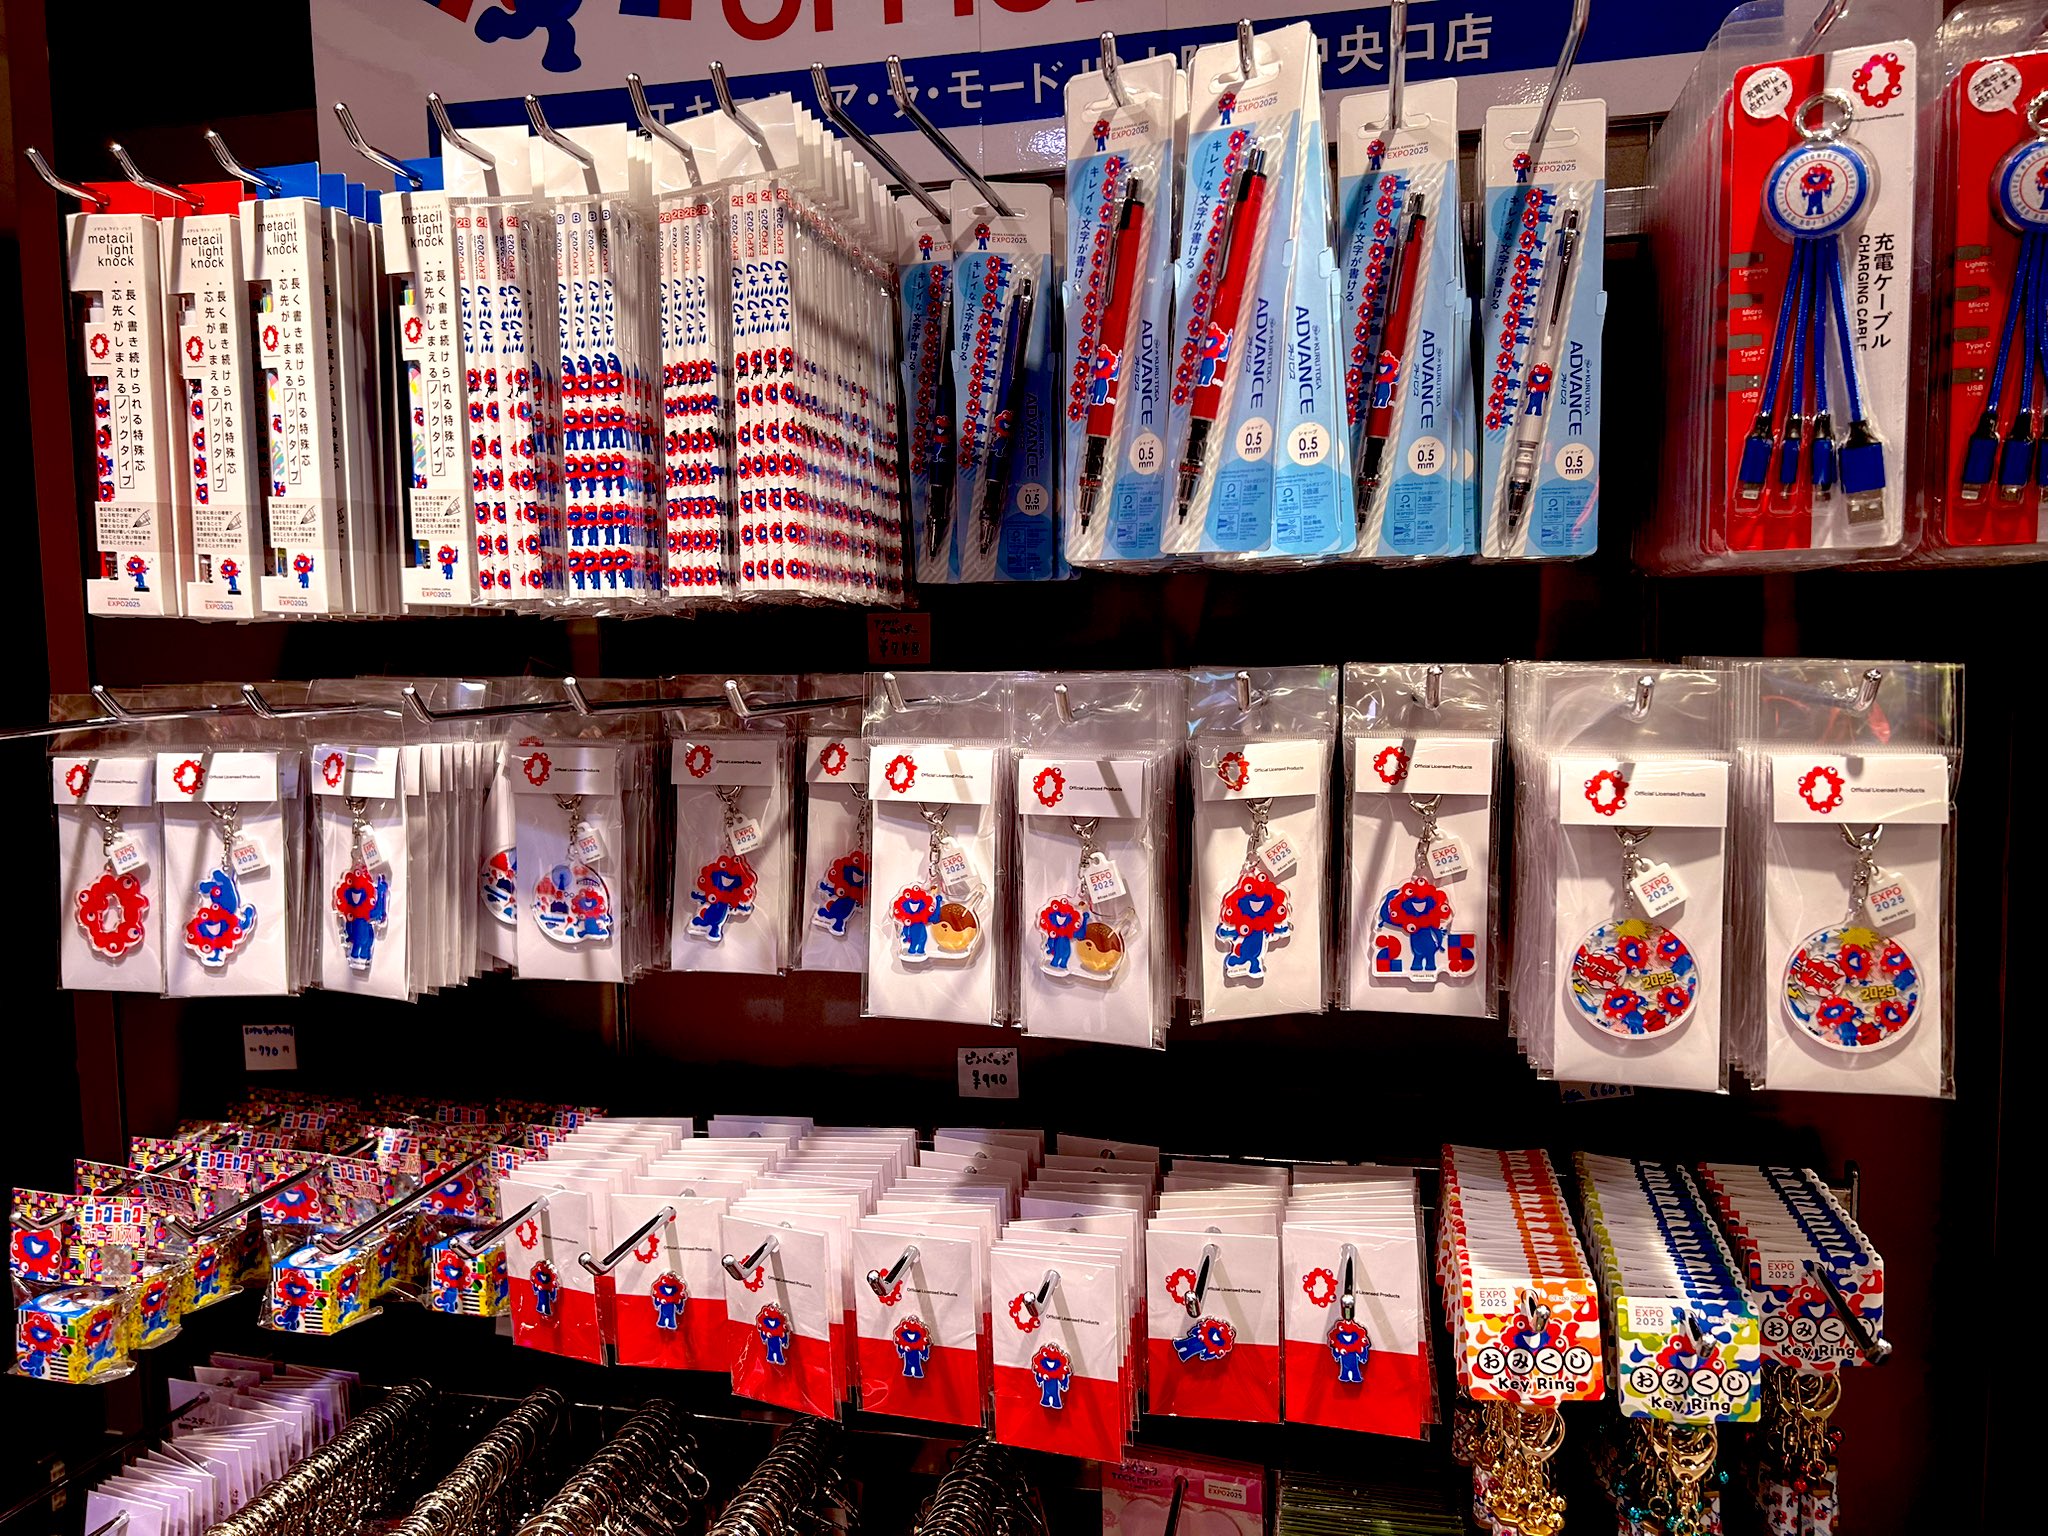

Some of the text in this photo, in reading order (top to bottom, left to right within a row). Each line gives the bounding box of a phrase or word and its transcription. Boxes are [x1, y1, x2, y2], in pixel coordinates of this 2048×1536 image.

[1745, 73, 1779, 101] 充電中は
[1748, 79, 1790, 113] 点灯します
[1237, 96, 1278, 113] EXPO2025
[1111, 124, 1149, 140] EXPO2025
[1386, 146, 1429, 160] EXPO2025
[1533, 164, 1576, 173] EXPO2025
[1185, 140, 1222, 279] キレイな文字が書ける。
[401, 211, 442, 224] metacil
[456, 217, 471, 228] 2B
[258, 218, 297, 232] metacil
[418, 224, 444, 238] light
[88, 233, 134, 244] metacil
[182, 234, 223, 246] metacil
[273, 232, 298, 245] light
[410, 236, 444, 248] knock
[992, 236, 1028, 244] EXPO2025
[106, 244, 134, 257] light
[198, 246, 224, 259] light
[266, 243, 298, 255] knock
[1345, 183, 1374, 311] キレイな文字が書ける。
[98, 256, 134, 267] knock
[190, 258, 224, 268] knock
[478, 234, 486, 280] EXPO2025
[1857, 234, 1870, 305] CHARGING
[1871, 232, 1894, 350] 充電ケーブル
[1250, 298, 1269, 409] ADVANCE
[1295, 305, 1315, 414] ADVANCE
[1141, 319, 1153, 426] ADVANCE
[1420, 329, 1435, 429] ADVANCE
[1568, 340, 1584, 436] ADVANCE
[1245, 432, 1262, 446] 0.5
[1299, 437, 1318, 450] 0.5
[1138, 447, 1154, 460] 0.5
[1244, 446, 1262, 454] mm
[1299, 451, 1318, 459] mm
[1417, 450, 1435, 462] 0.5
[1138, 460, 1154, 468] mm
[1565, 456, 1583, 467] 0.5
[1024, 494, 1040, 504] 0.5
[734, 826, 754, 839] EXPO
[736, 833, 756, 846] 2025
[114, 846, 135, 858] EXPO
[234, 846, 256, 858] EXPO
[1266, 841, 1288, 860] EXPO
[1270, 848, 1292, 866] 2025
[1432, 847, 1458, 860] EXPO
[118, 852, 138, 864] 2025
[238, 853, 258, 865] 2025
[942, 855, 963, 868] EXPO
[1435, 855, 1460, 867] 2025
[946, 863, 966, 874] 2025
[1090, 871, 1112, 884] EXPO
[1092, 879, 1114, 891] 2025
[1641, 874, 1670, 896] EXPO
[1647, 884, 1674, 902] 2025
[1870, 886, 1902, 904] EXPO
[1874, 896, 1905, 913] 2025
[1576, 955, 1623, 983] ミャクミャク
[1792, 959, 1840, 988] ミャクミャク
[1641, 972, 1676, 990] 2025
[1860, 986, 1896, 1000] 2025
[972, 1070, 1008, 1090] ¥990
[85, 1206, 142, 1223] ミャクミャク
[1768, 1262, 1795, 1271] EXPO
[1480, 1290, 1506, 1298] EXPO
[1635, 1309, 1664, 1317] EXPO
[1636, 1318, 1664, 1326] 2025
[1781, 1344, 1855, 1358] Key Ring
[1483, 1352, 1586, 1369] おみくじ
[1499, 1378, 1575, 1392] Key Ring
[1636, 1373, 1744, 1391] おみくじ
[1651, 1396, 1730, 1413] Key Ring
